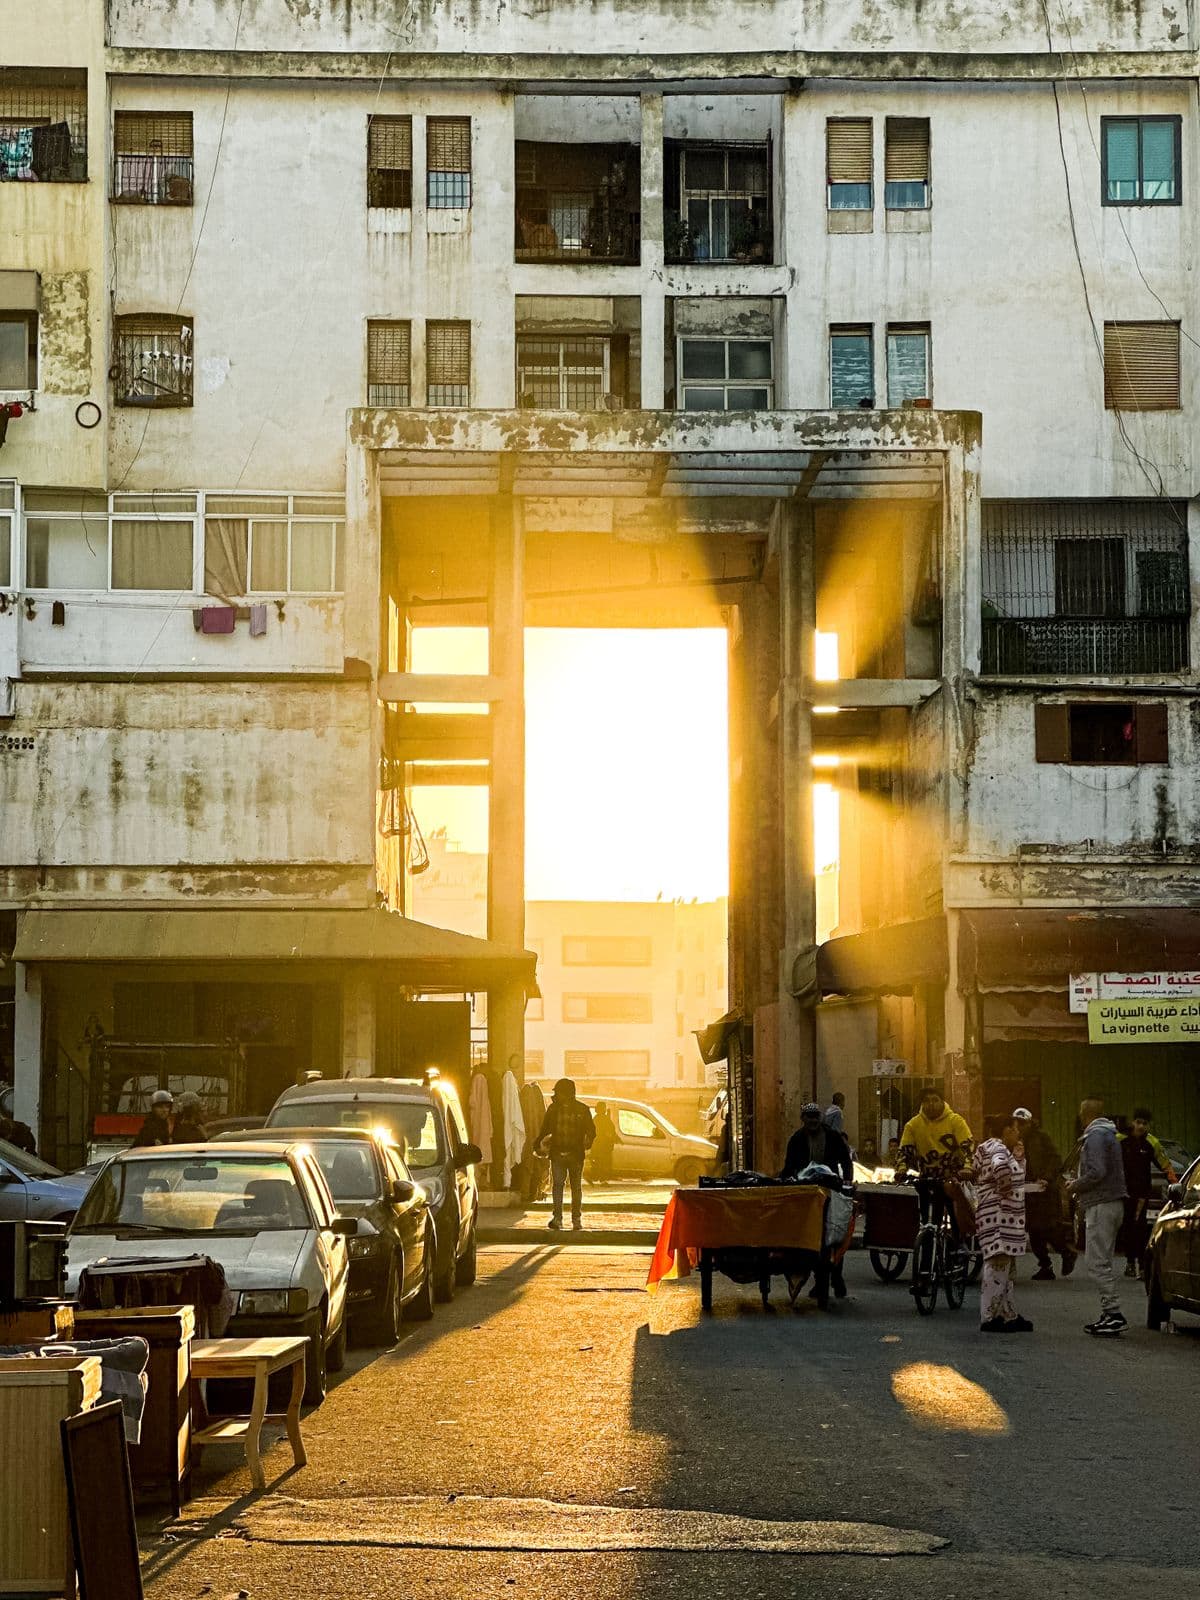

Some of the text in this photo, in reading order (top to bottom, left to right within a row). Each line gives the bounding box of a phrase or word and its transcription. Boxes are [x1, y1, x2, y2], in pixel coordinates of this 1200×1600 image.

[1103, 973, 1161, 985] الصفا
[1100, 1007, 1144, 1020] السيارات
[1147, 1006, 1178, 1019] ضريبة
[1102, 1022, 1170, 1036] La vignette
